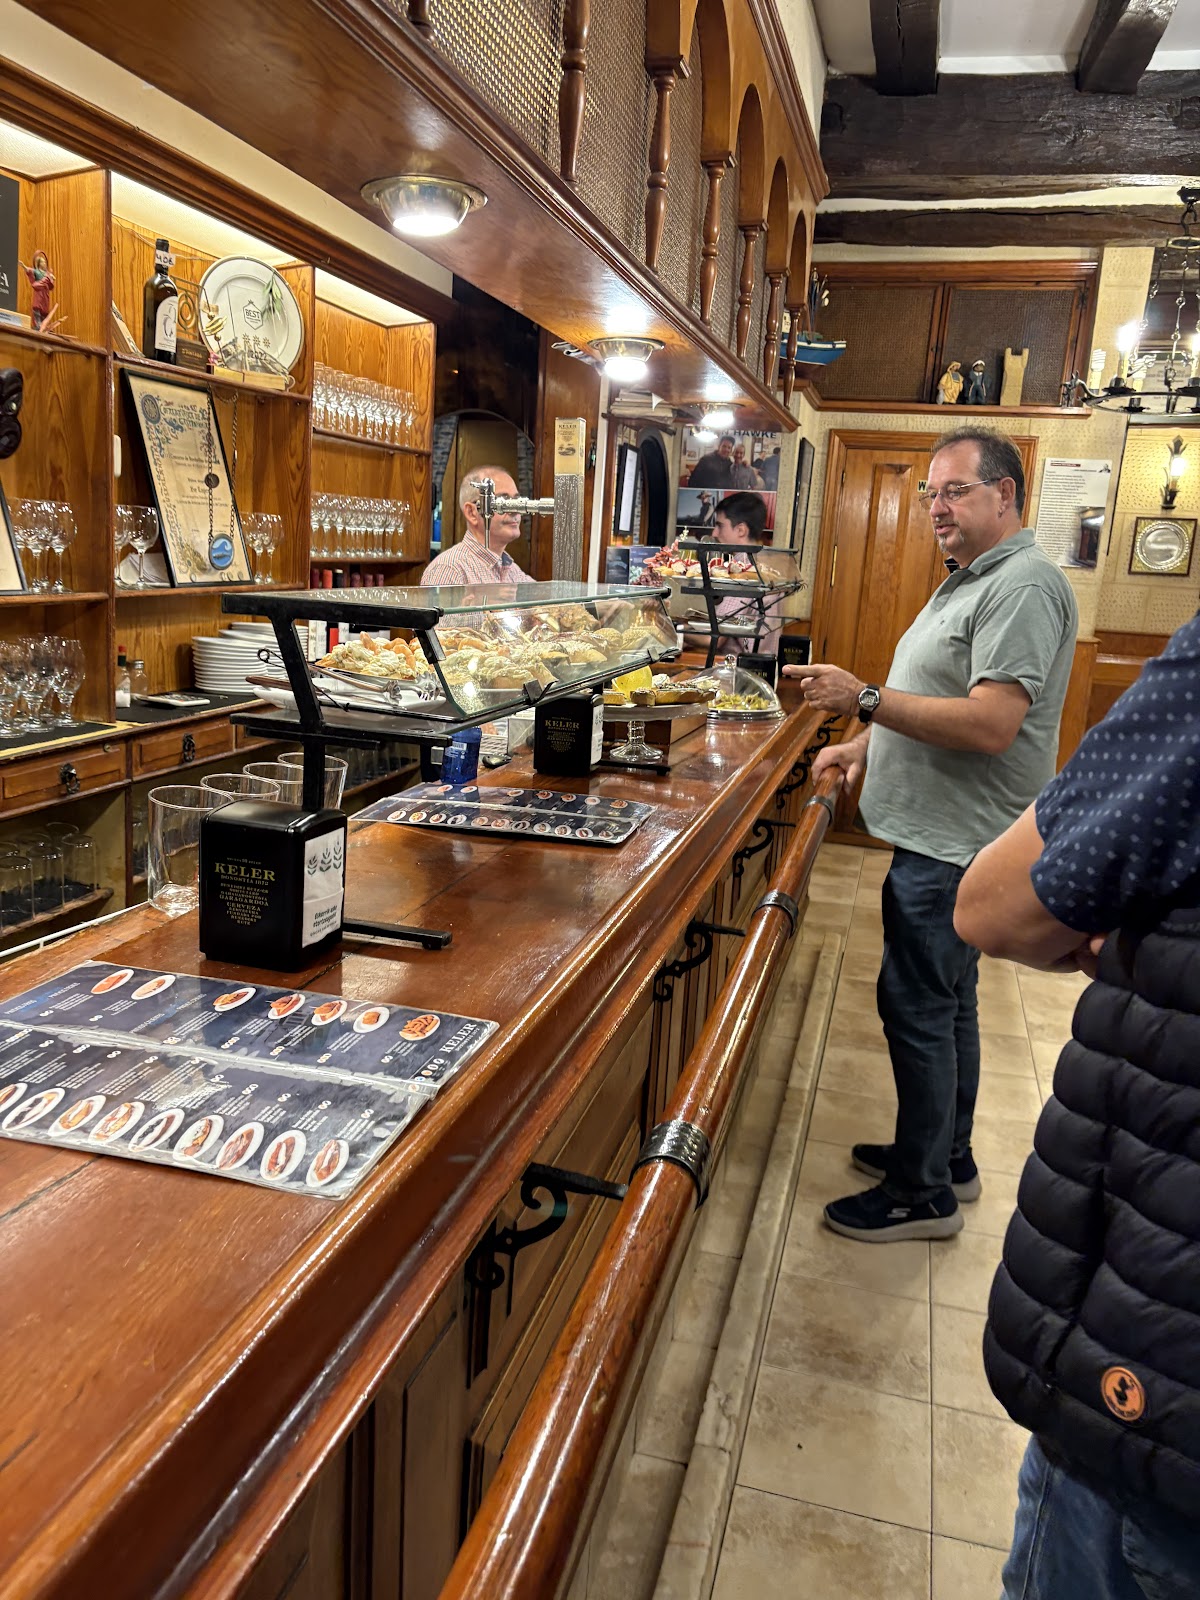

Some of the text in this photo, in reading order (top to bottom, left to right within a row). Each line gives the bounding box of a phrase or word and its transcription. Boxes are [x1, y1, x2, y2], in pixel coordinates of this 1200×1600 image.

[245, 309, 260, 319] BEST
[733, 430, 777, 439] HAWKE
[545, 720, 579, 730] KELER
[214, 862, 275, 881] KELER
[439, 1023, 477, 1053] KELER
